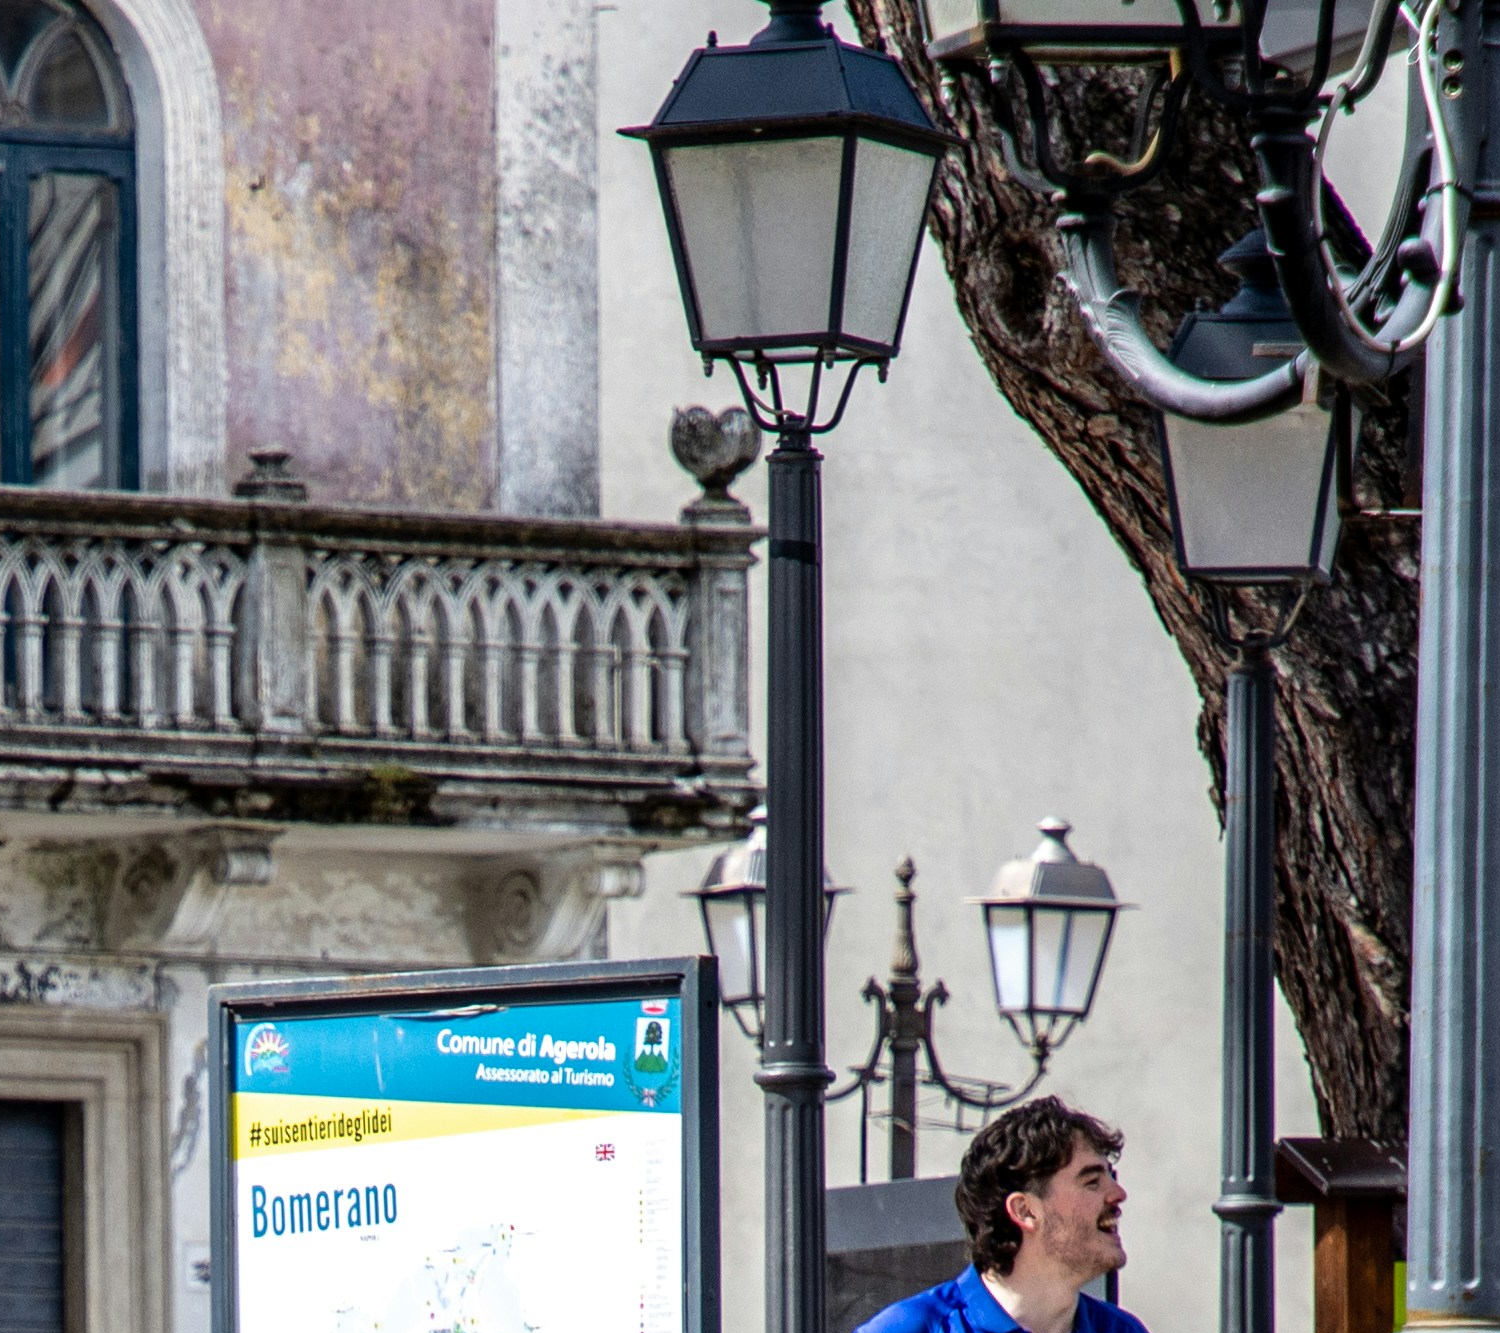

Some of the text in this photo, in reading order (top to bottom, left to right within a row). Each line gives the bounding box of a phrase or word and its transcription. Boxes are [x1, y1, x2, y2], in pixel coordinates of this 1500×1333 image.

[437, 1029, 616, 1065] Comune di Agerola
[475, 1063, 615, 1087] Assessorato al Turismo
[250, 1107, 392, 1147] #suisentierideglidei
[252, 1183, 398, 1238] Bomerano
